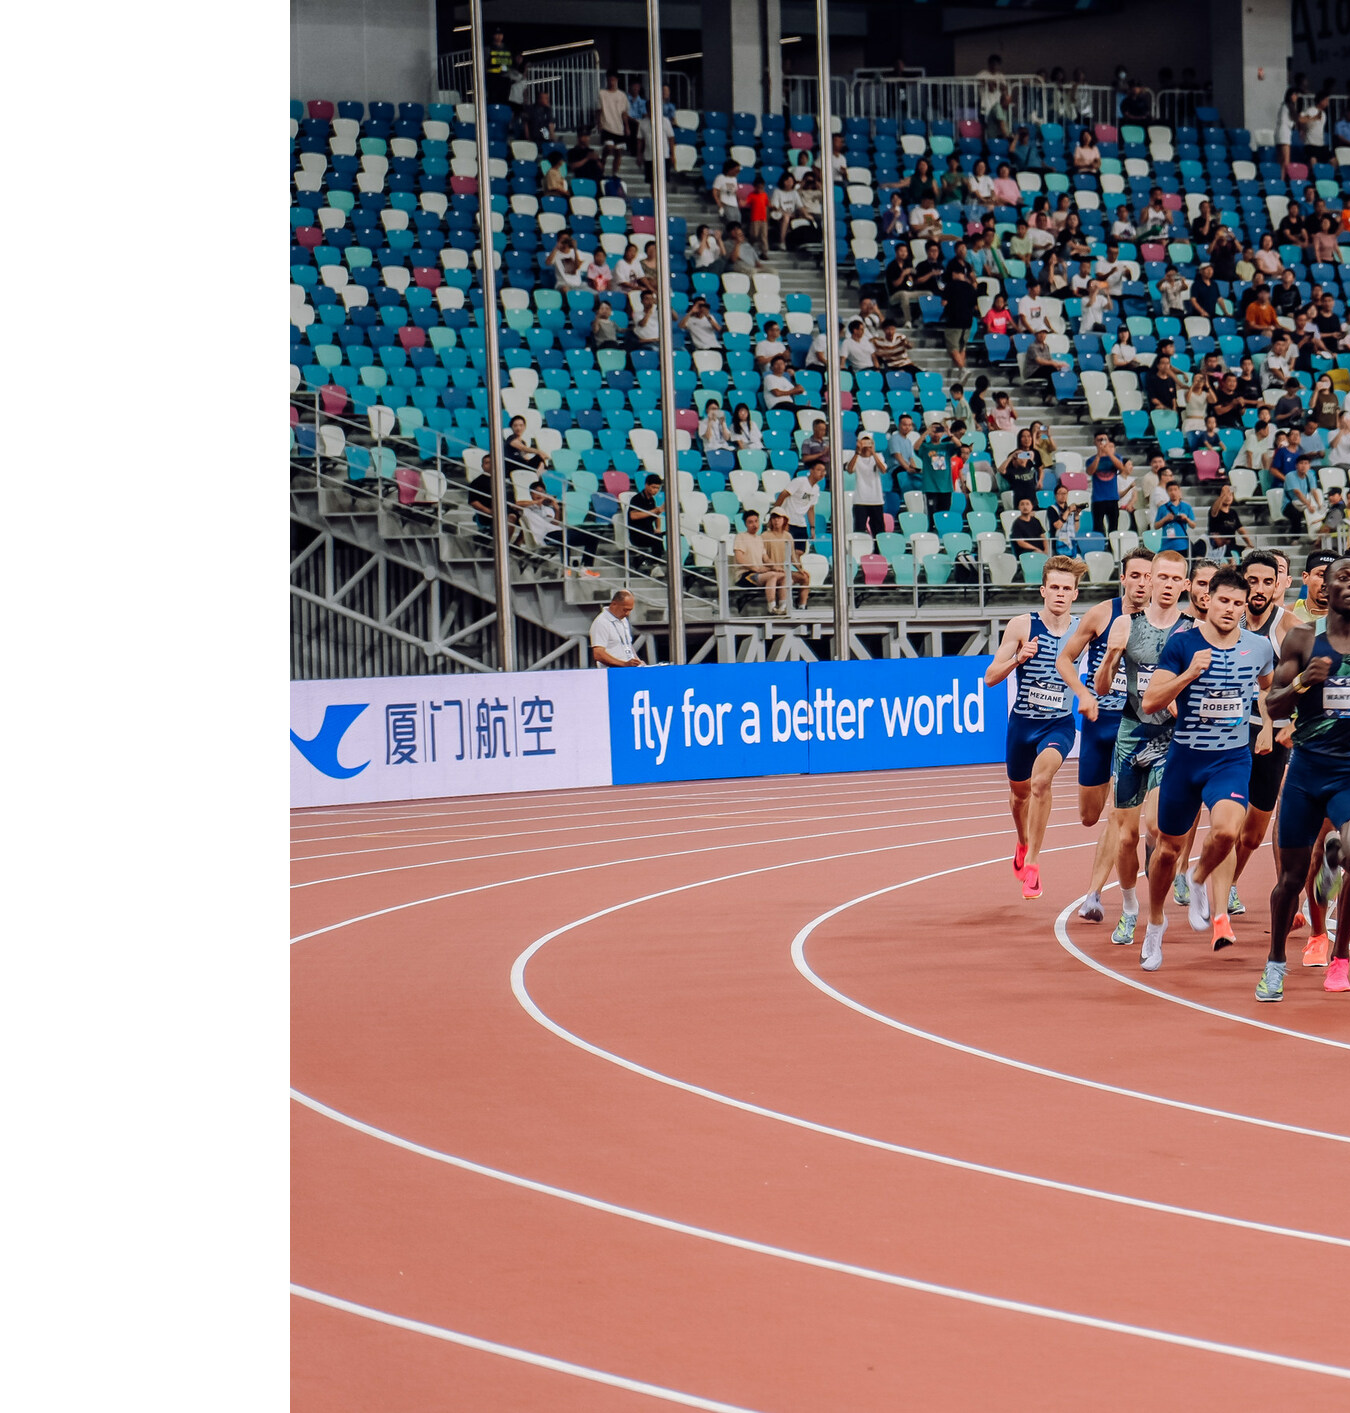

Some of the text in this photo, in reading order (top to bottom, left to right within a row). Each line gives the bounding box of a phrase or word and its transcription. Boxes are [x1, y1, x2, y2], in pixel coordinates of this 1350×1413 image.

[1029, 691, 1063, 703] MEZIANE
[1202, 703, 1241, 711] ROBERT
[386, 695, 556, 765] 厦门航空
[631, 678, 985, 765] fly for a better world
